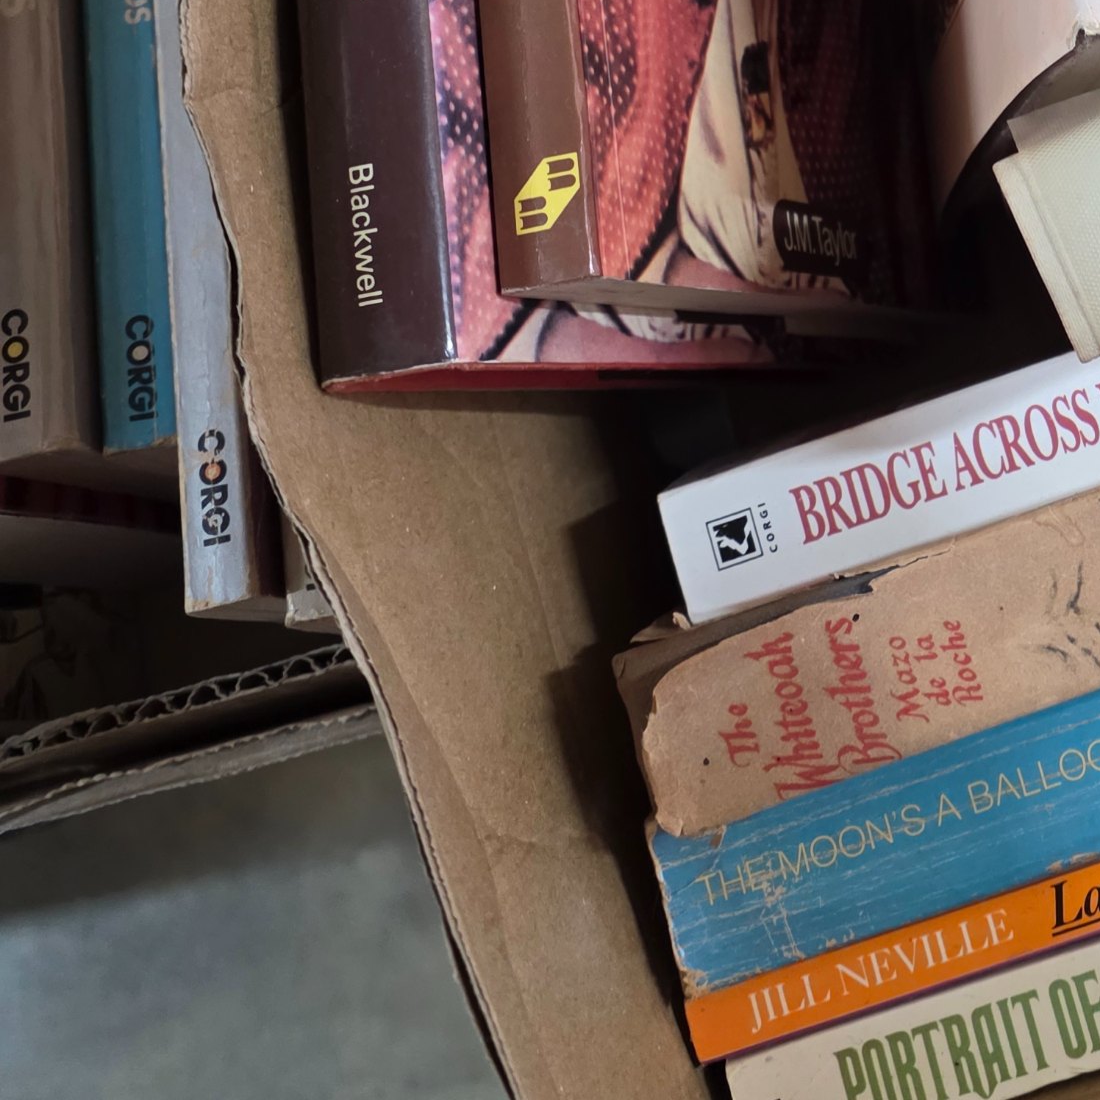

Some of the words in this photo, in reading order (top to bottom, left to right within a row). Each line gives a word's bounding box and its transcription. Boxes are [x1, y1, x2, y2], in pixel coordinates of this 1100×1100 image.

[348, 162, 384, 308] Blackwell
[0, 308, 32, 423] CORGI
[125, 314, 159, 422] CORGI
[197, 428, 232, 548] CORGI
[788, 439, 949, 545] BRIDGE
[952, 388, 1100, 492] ACROSS
[757, 502, 778, 554] CORGI
[823, 616, 903, 781] Brothers
[888, 635, 931, 724] Mazo
[912, 633, 937, 664] la
[922, 675, 953, 708] de
[939, 618, 985, 707] Roche
[717, 701, 761, 769] The
[695, 857, 769, 907] THE
[777, 802, 927, 886] MOON'S
[935, 792, 963, 828] A
[746, 979, 832, 1034] JILL
[834, 908, 1016, 998] NEVILLE
[833, 988, 1051, 1100] PORTRAIT
